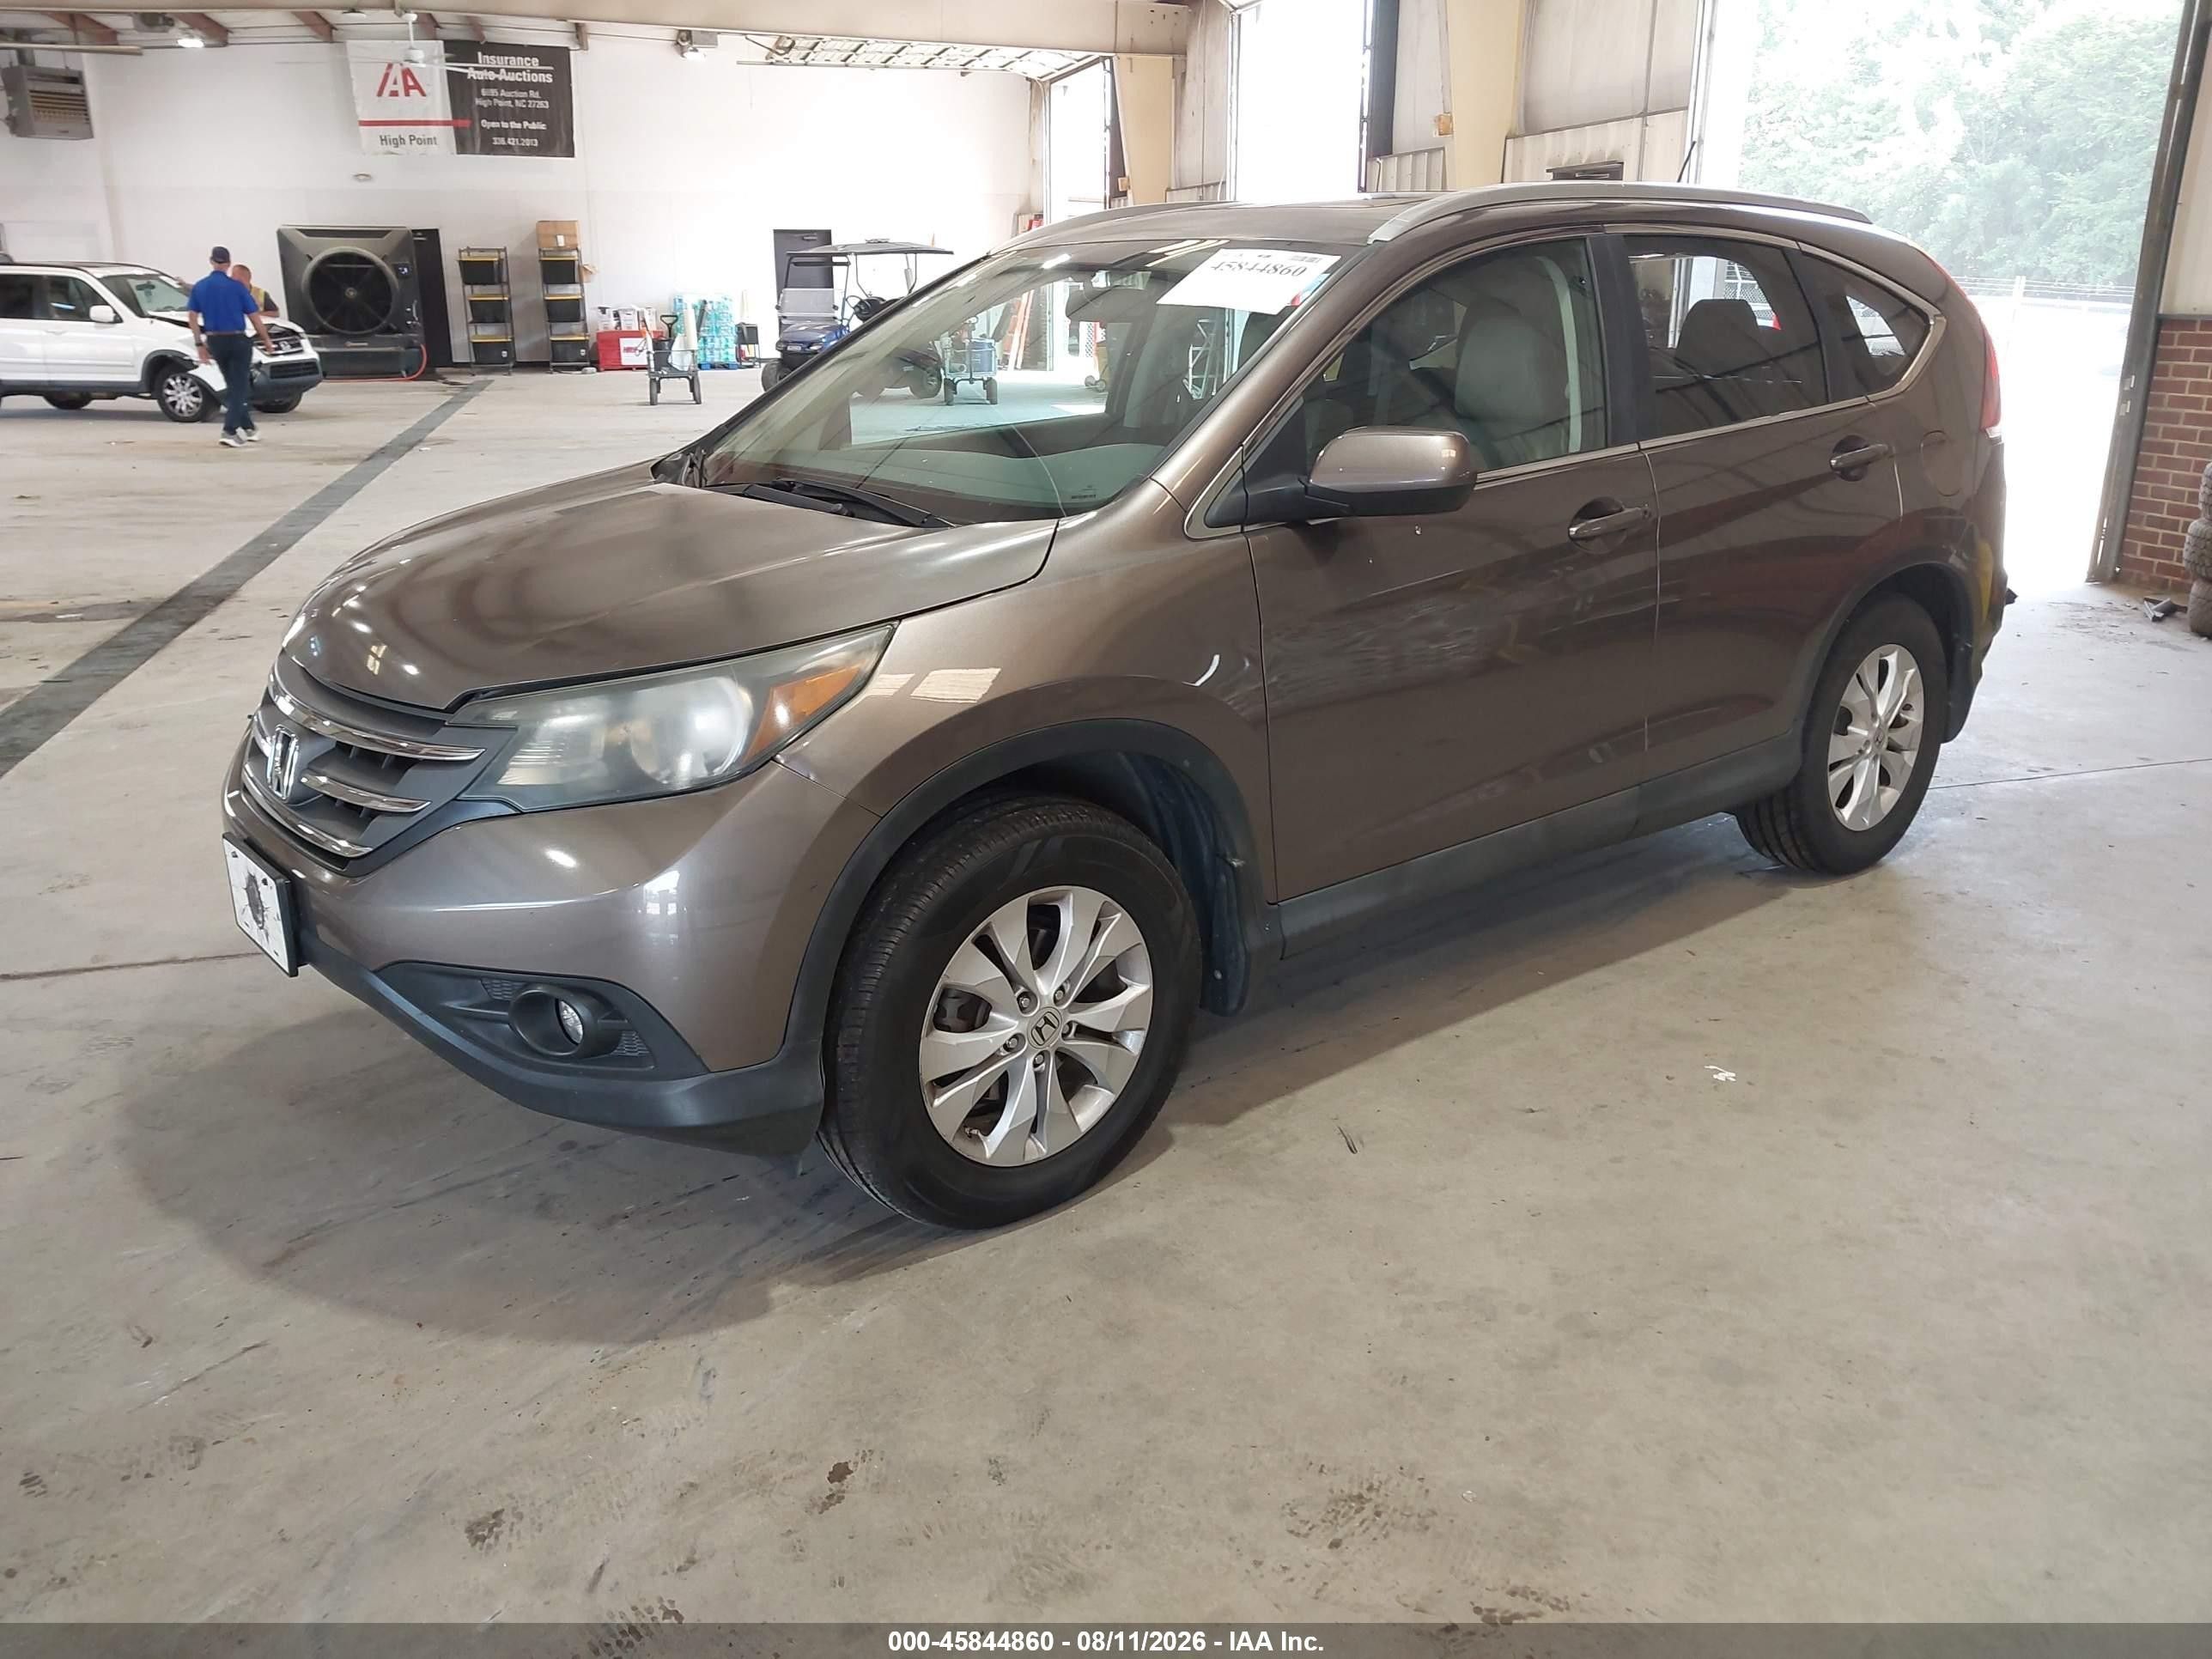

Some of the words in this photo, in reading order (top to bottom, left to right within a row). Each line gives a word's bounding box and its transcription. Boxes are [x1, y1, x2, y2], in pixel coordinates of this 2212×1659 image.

[477, 52, 540, 66] Insurance
[467, 67, 495, 81] Auto
[498, 69, 553, 82] Auctions
[500, 89, 528, 98] Auction
[528, 90, 542, 99] Rd.
[475, 98, 492, 107] High
[514, 99, 526, 107] NC
[481, 119, 500, 130] Open
[523, 121, 547, 130] Public
[379, 135, 406, 148] High
[408, 135, 438, 145] Point
